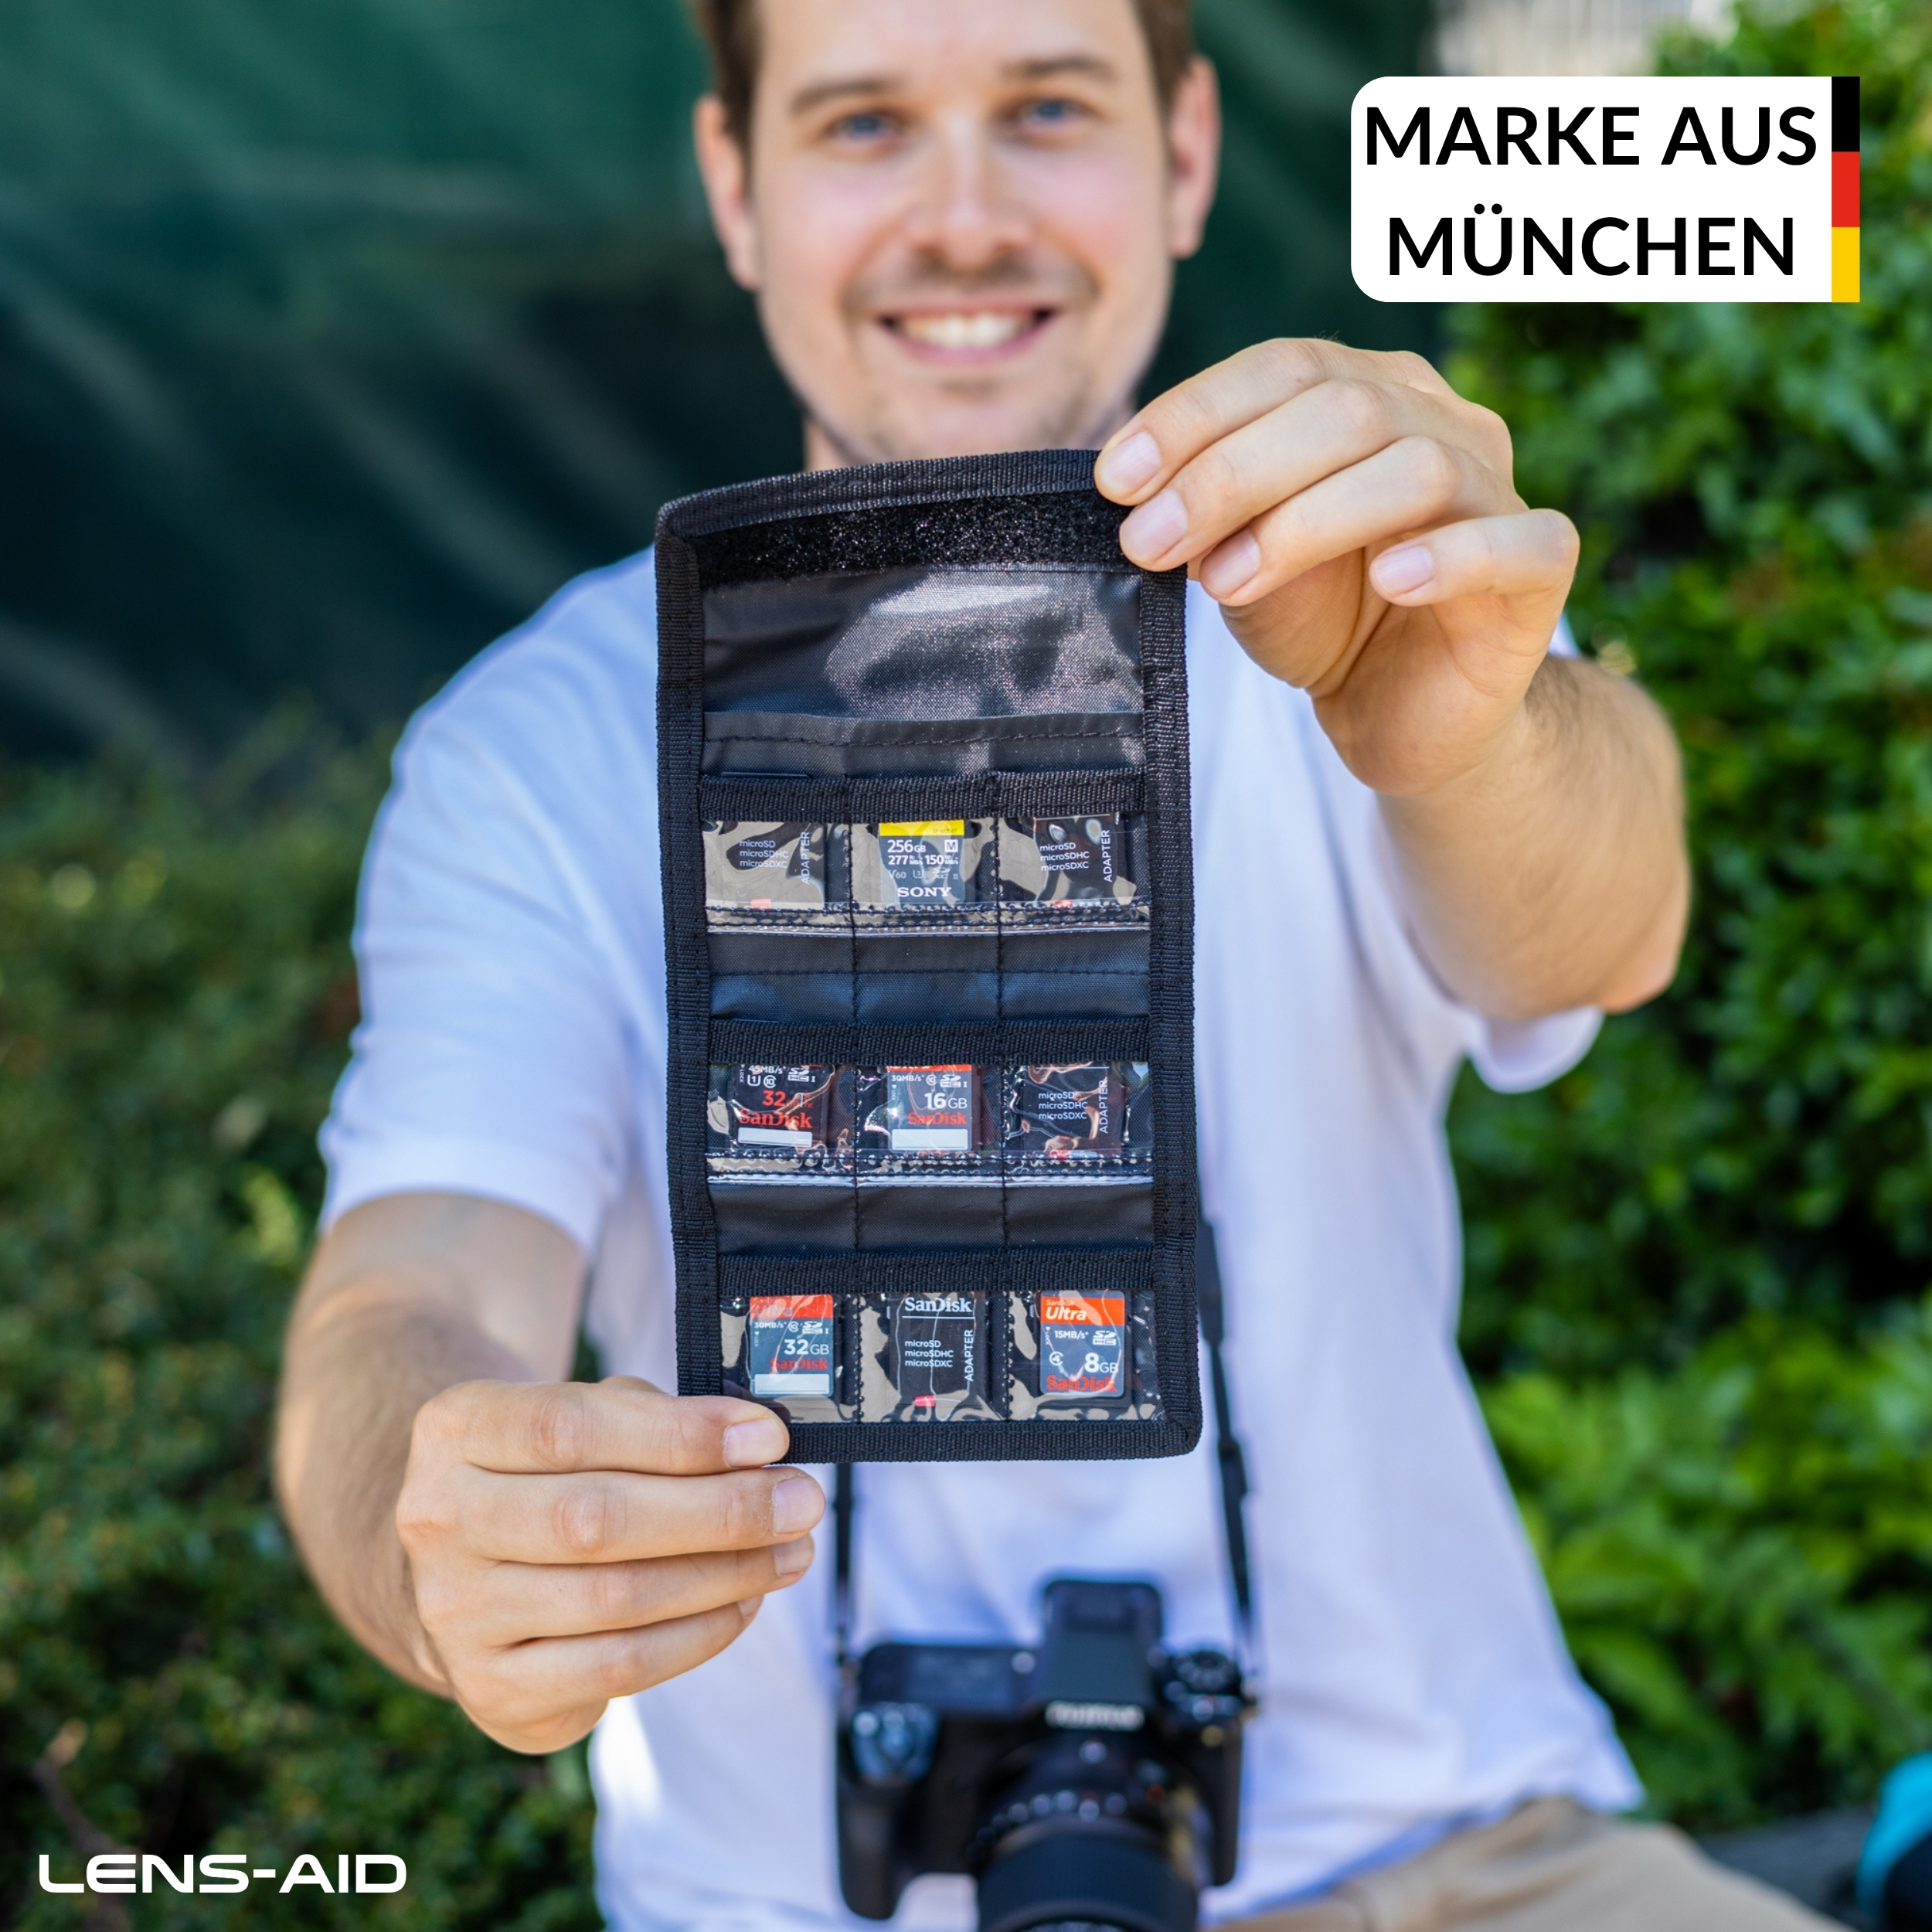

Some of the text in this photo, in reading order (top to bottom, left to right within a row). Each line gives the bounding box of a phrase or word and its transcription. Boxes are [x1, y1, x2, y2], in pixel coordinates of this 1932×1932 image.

[946, 840, 957, 852] M
[1039, 842, 1077, 852] microSD
[739, 850, 789, 859] microSDHC
[801, 832, 810, 885] ADAPTER
[888, 855, 909, 865] 277
[924, 855, 944, 865] 150
[1040, 851, 1090, 862] microSDHC
[1101, 829, 1113, 883] ADAPTER
[739, 860, 788, 869] microSDXC
[1041, 861, 1089, 872] microSDXC
[897, 886, 952, 897] SONY
[1039, 1101, 1088, 1110] microSDHC
[1099, 1080, 1108, 1134] ADAPTER
[739, 1108, 813, 1128] SanDisk
[907, 1111, 968, 1125] SanDisk
[1039, 1111, 1087, 1120] microSDXC
[904, 1297, 973, 1312] SanDisk
[1046, 1306, 1087, 1321] Ultra
[904, 1339, 941, 1348] microSD
[904, 1349, 954, 1358] microSDHC
[964, 1329, 974, 1382] ADAPTER
[770, 1358, 829, 1370] SanDisk
[1046, 1374, 1117, 1392] SanDisk
